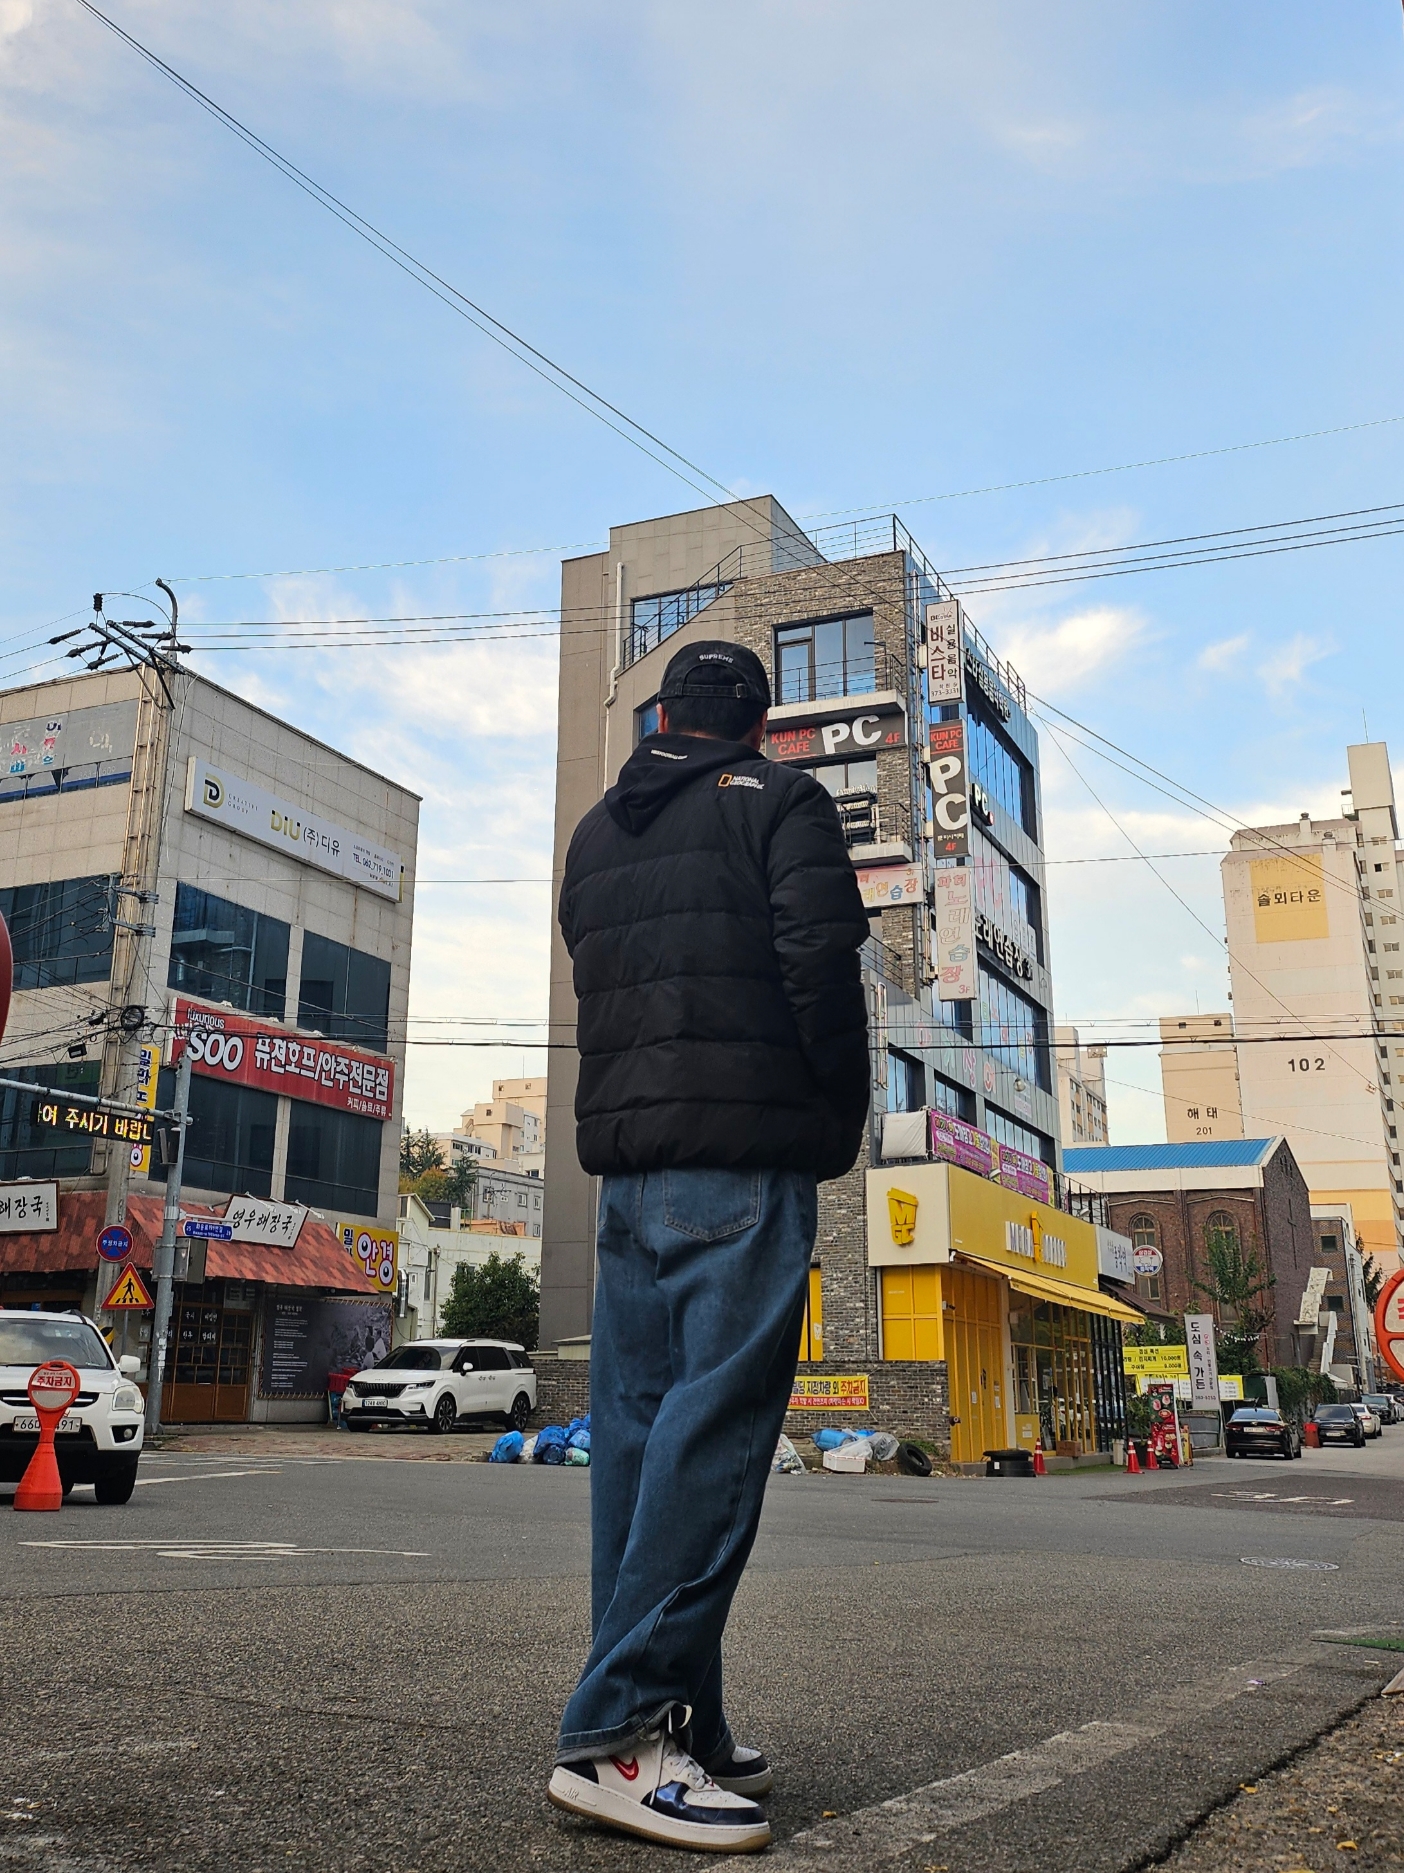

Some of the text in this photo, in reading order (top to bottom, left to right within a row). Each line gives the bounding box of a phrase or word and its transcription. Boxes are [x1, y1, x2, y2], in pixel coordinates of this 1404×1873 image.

[699, 653, 734, 664] SUPREME
[930, 625, 946, 680] 비스타
[771, 727, 816, 744] KUN PC
[821, 714, 882, 755] PC
[884, 731, 901, 744] 4F
[930, 729, 963, 742] KUN PC
[777, 740, 811, 755] CAFE
[935, 738, 959, 751] CAFE
[930, 755, 968, 831] PC
[973, 783, 989, 817] PC
[945, 842, 957, 852] 4F
[1256, 888, 1322, 907] 솔뫼타운
[958, 984, 971, 994] 3F
[1287, 1057, 1326, 1072] 102
[65, 1107, 108, 1135] 주시기
[1195, 1126, 1212, 1136] 201
[357, 1231, 394, 1287] 안경
[37, 1375, 72, 1387] 주차금지
[806, 1380, 831, 1395] 지정차량
[832, 1380, 839, 1395] 외
[840, 1379, 866, 1395] 주차금지
